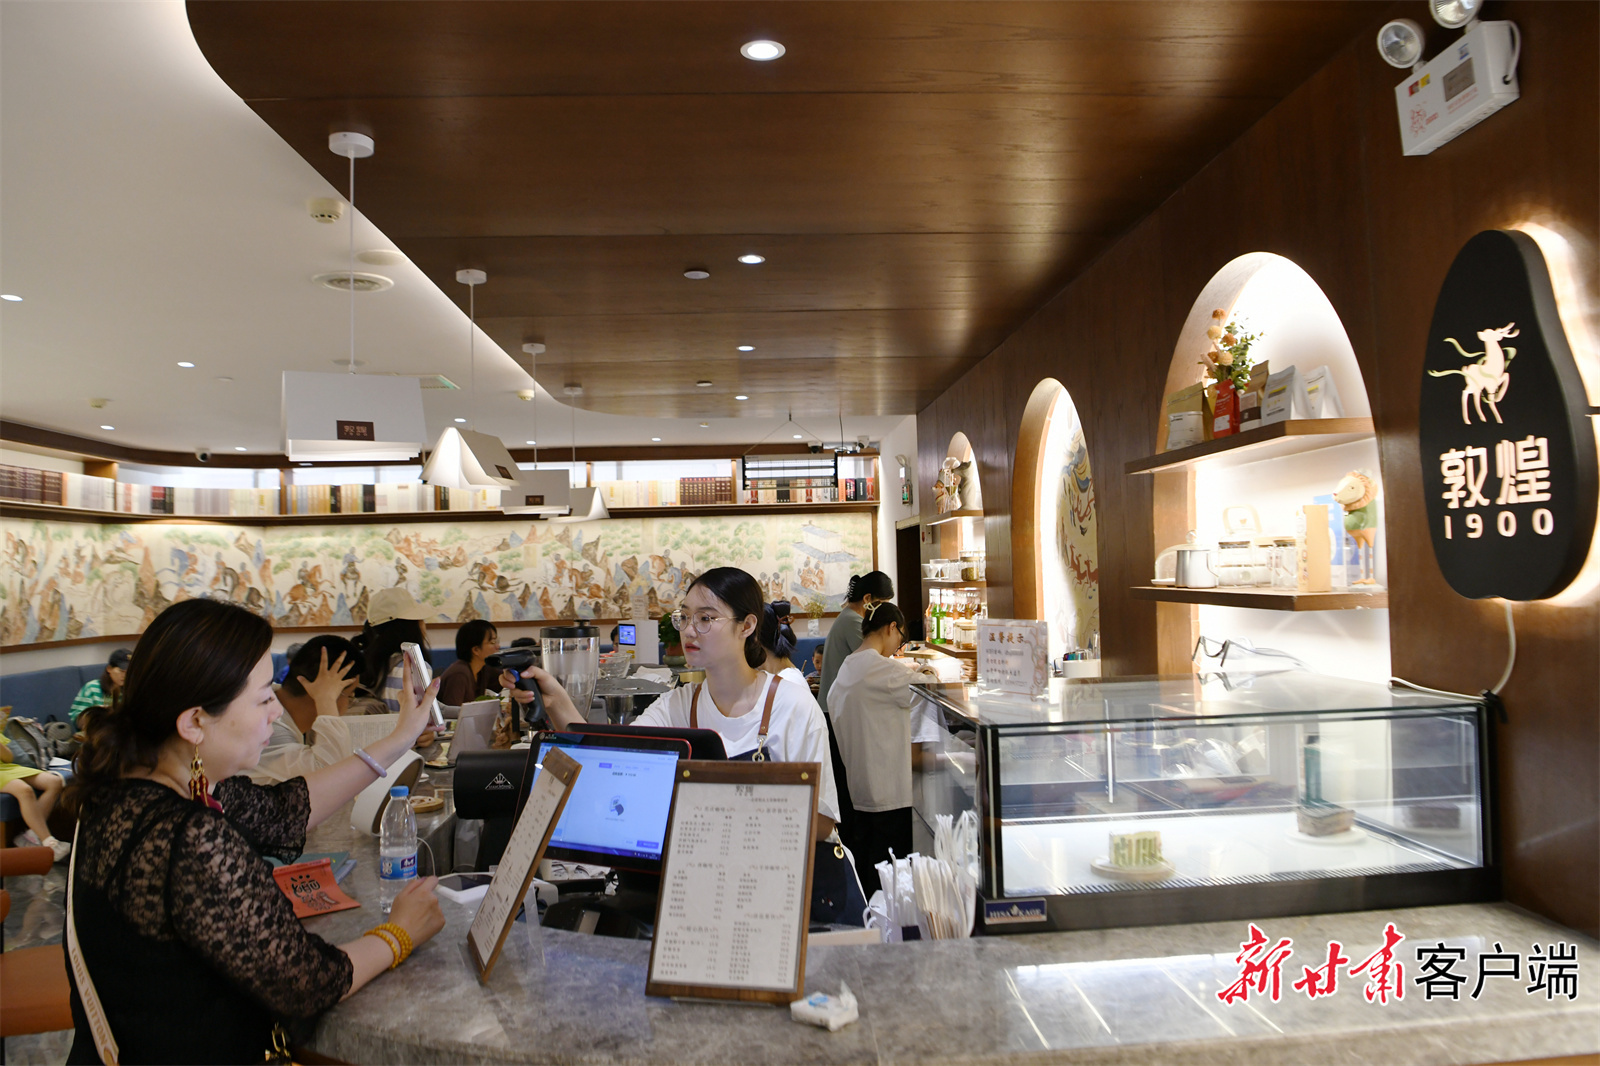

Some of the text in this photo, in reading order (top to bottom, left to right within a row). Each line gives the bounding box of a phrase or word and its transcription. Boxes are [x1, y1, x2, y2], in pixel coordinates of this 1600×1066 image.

[1439, 434, 1552, 510] 敦煌
[1443, 507, 1554, 540] 1900
[71, 947, 108, 1046] LOUIS VUITTON
